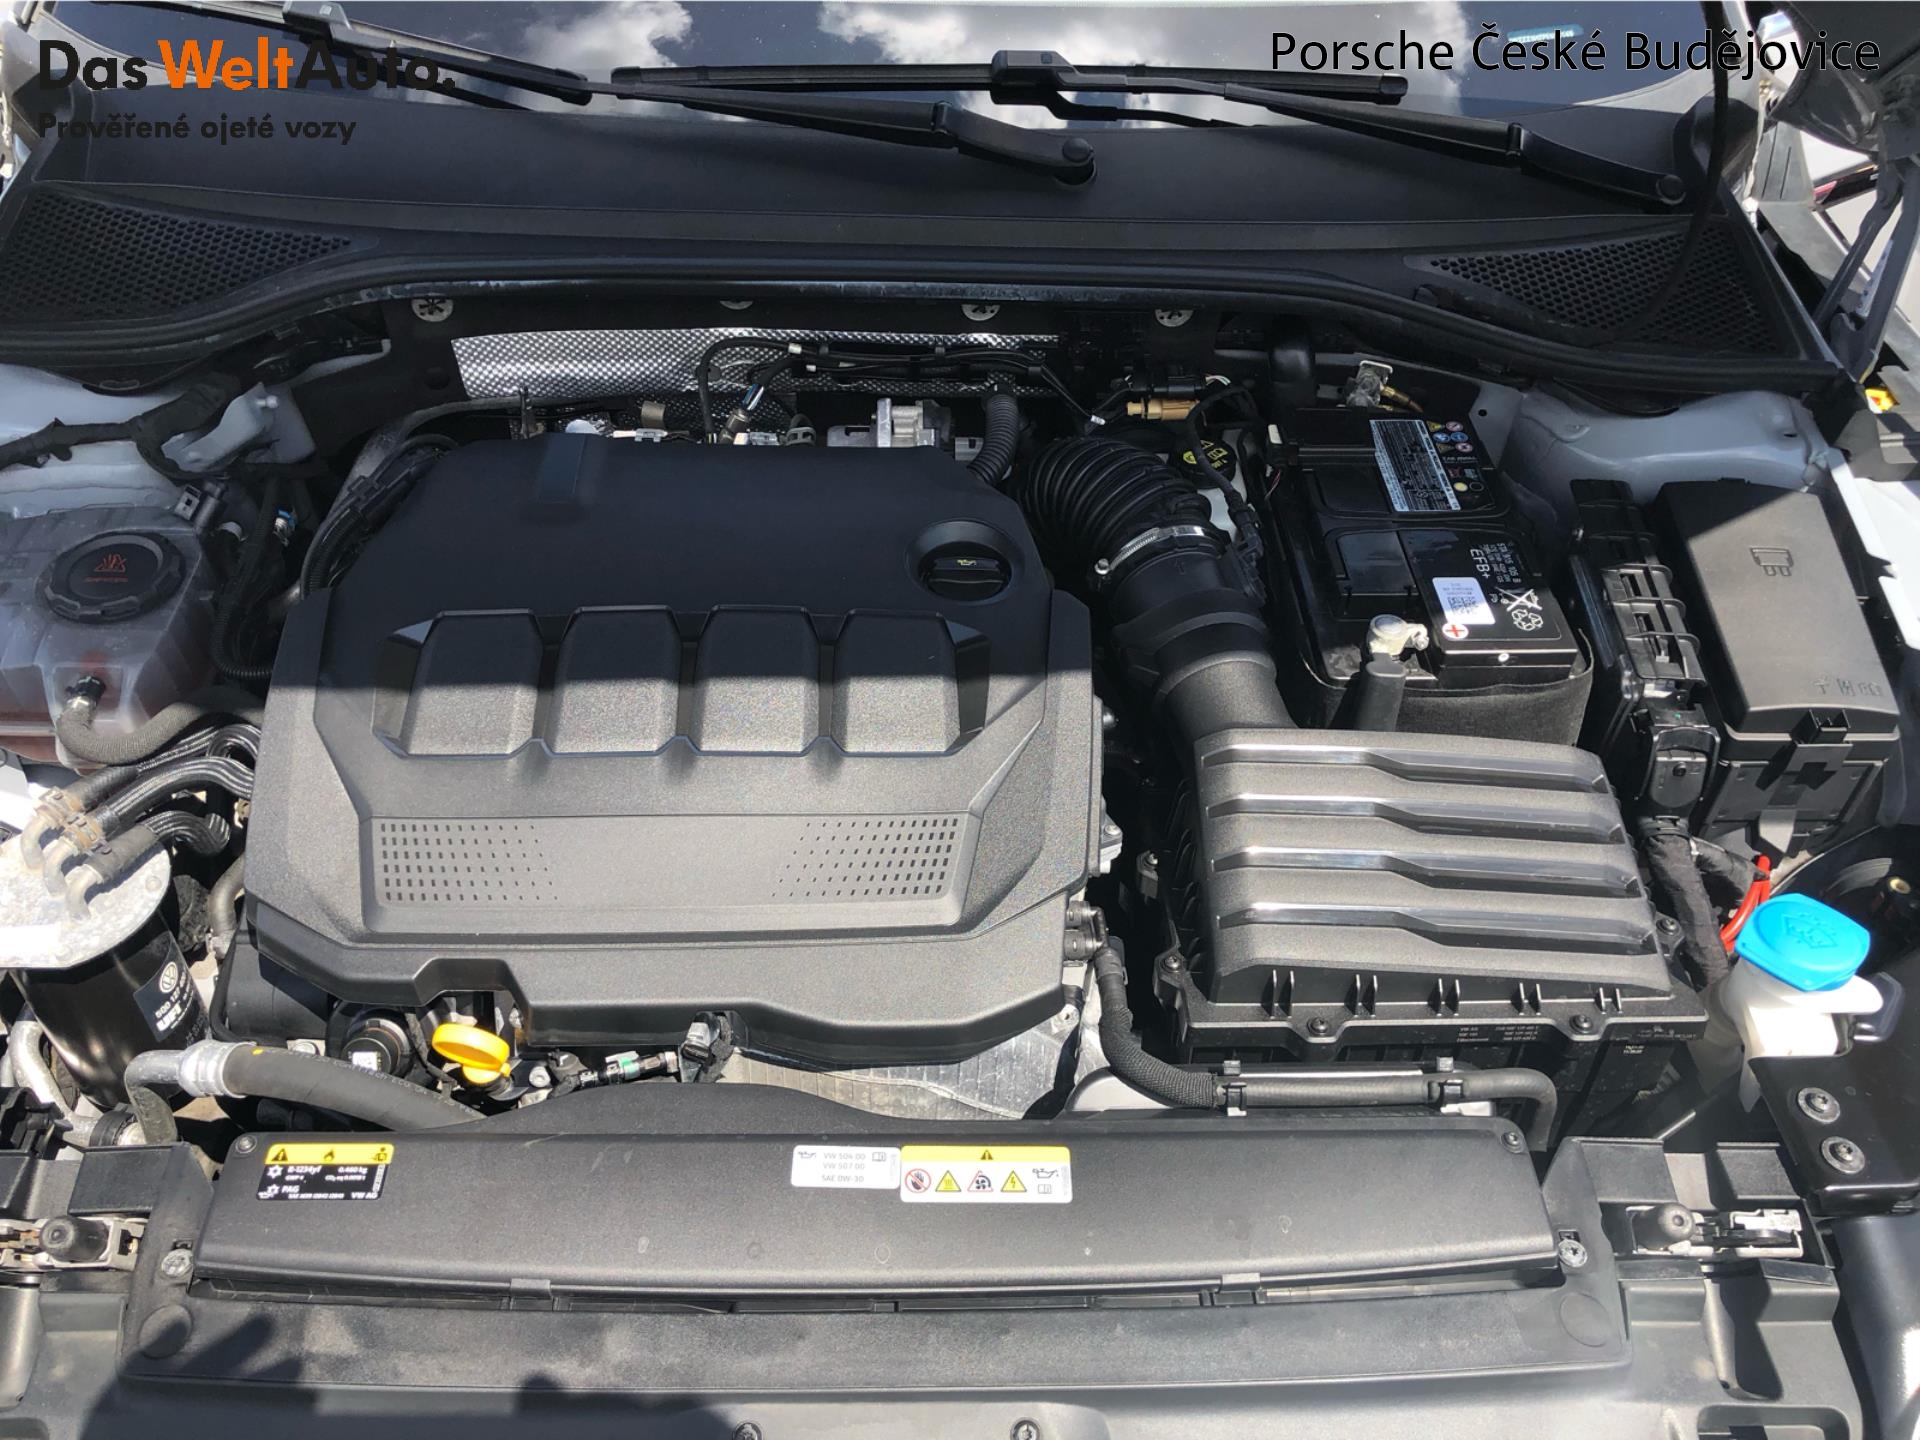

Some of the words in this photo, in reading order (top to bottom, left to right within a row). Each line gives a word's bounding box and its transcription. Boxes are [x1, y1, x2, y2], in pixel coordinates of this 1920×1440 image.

[1469, 548, 1491, 579] EFB+
[824, 1152, 837, 1160] VW
[839, 1152, 854, 1160] 504
[855, 1153, 867, 1161] 00
[823, 1162, 837, 1170] VW
[855, 1163, 866, 1171] 00
[821, 1174, 837, 1182] SAE
[837, 1174, 866, 1183] 0W-30
[281, 1185, 300, 1194] PAG
[351, 1192, 365, 1200] VW
